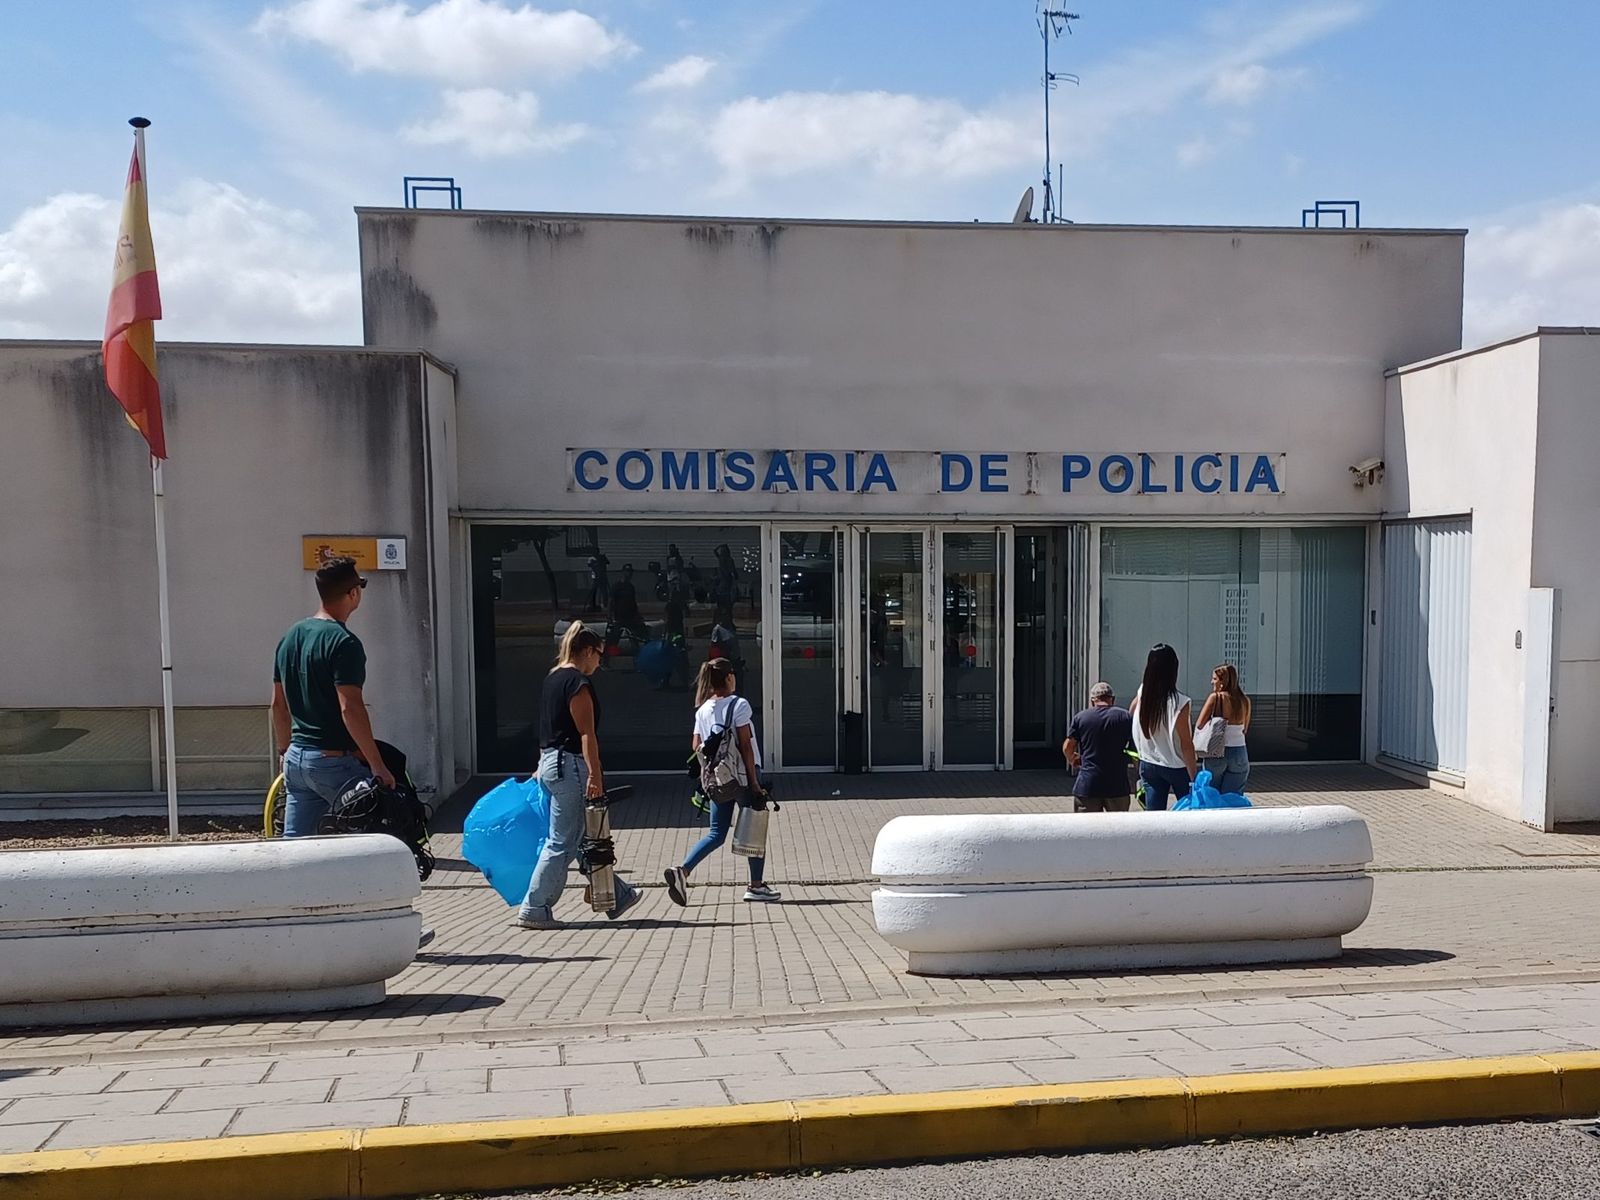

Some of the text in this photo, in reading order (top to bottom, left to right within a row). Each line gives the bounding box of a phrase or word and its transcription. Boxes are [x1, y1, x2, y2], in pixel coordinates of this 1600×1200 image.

[575, 450, 1279, 493] COMISARIA DE POLICIA
